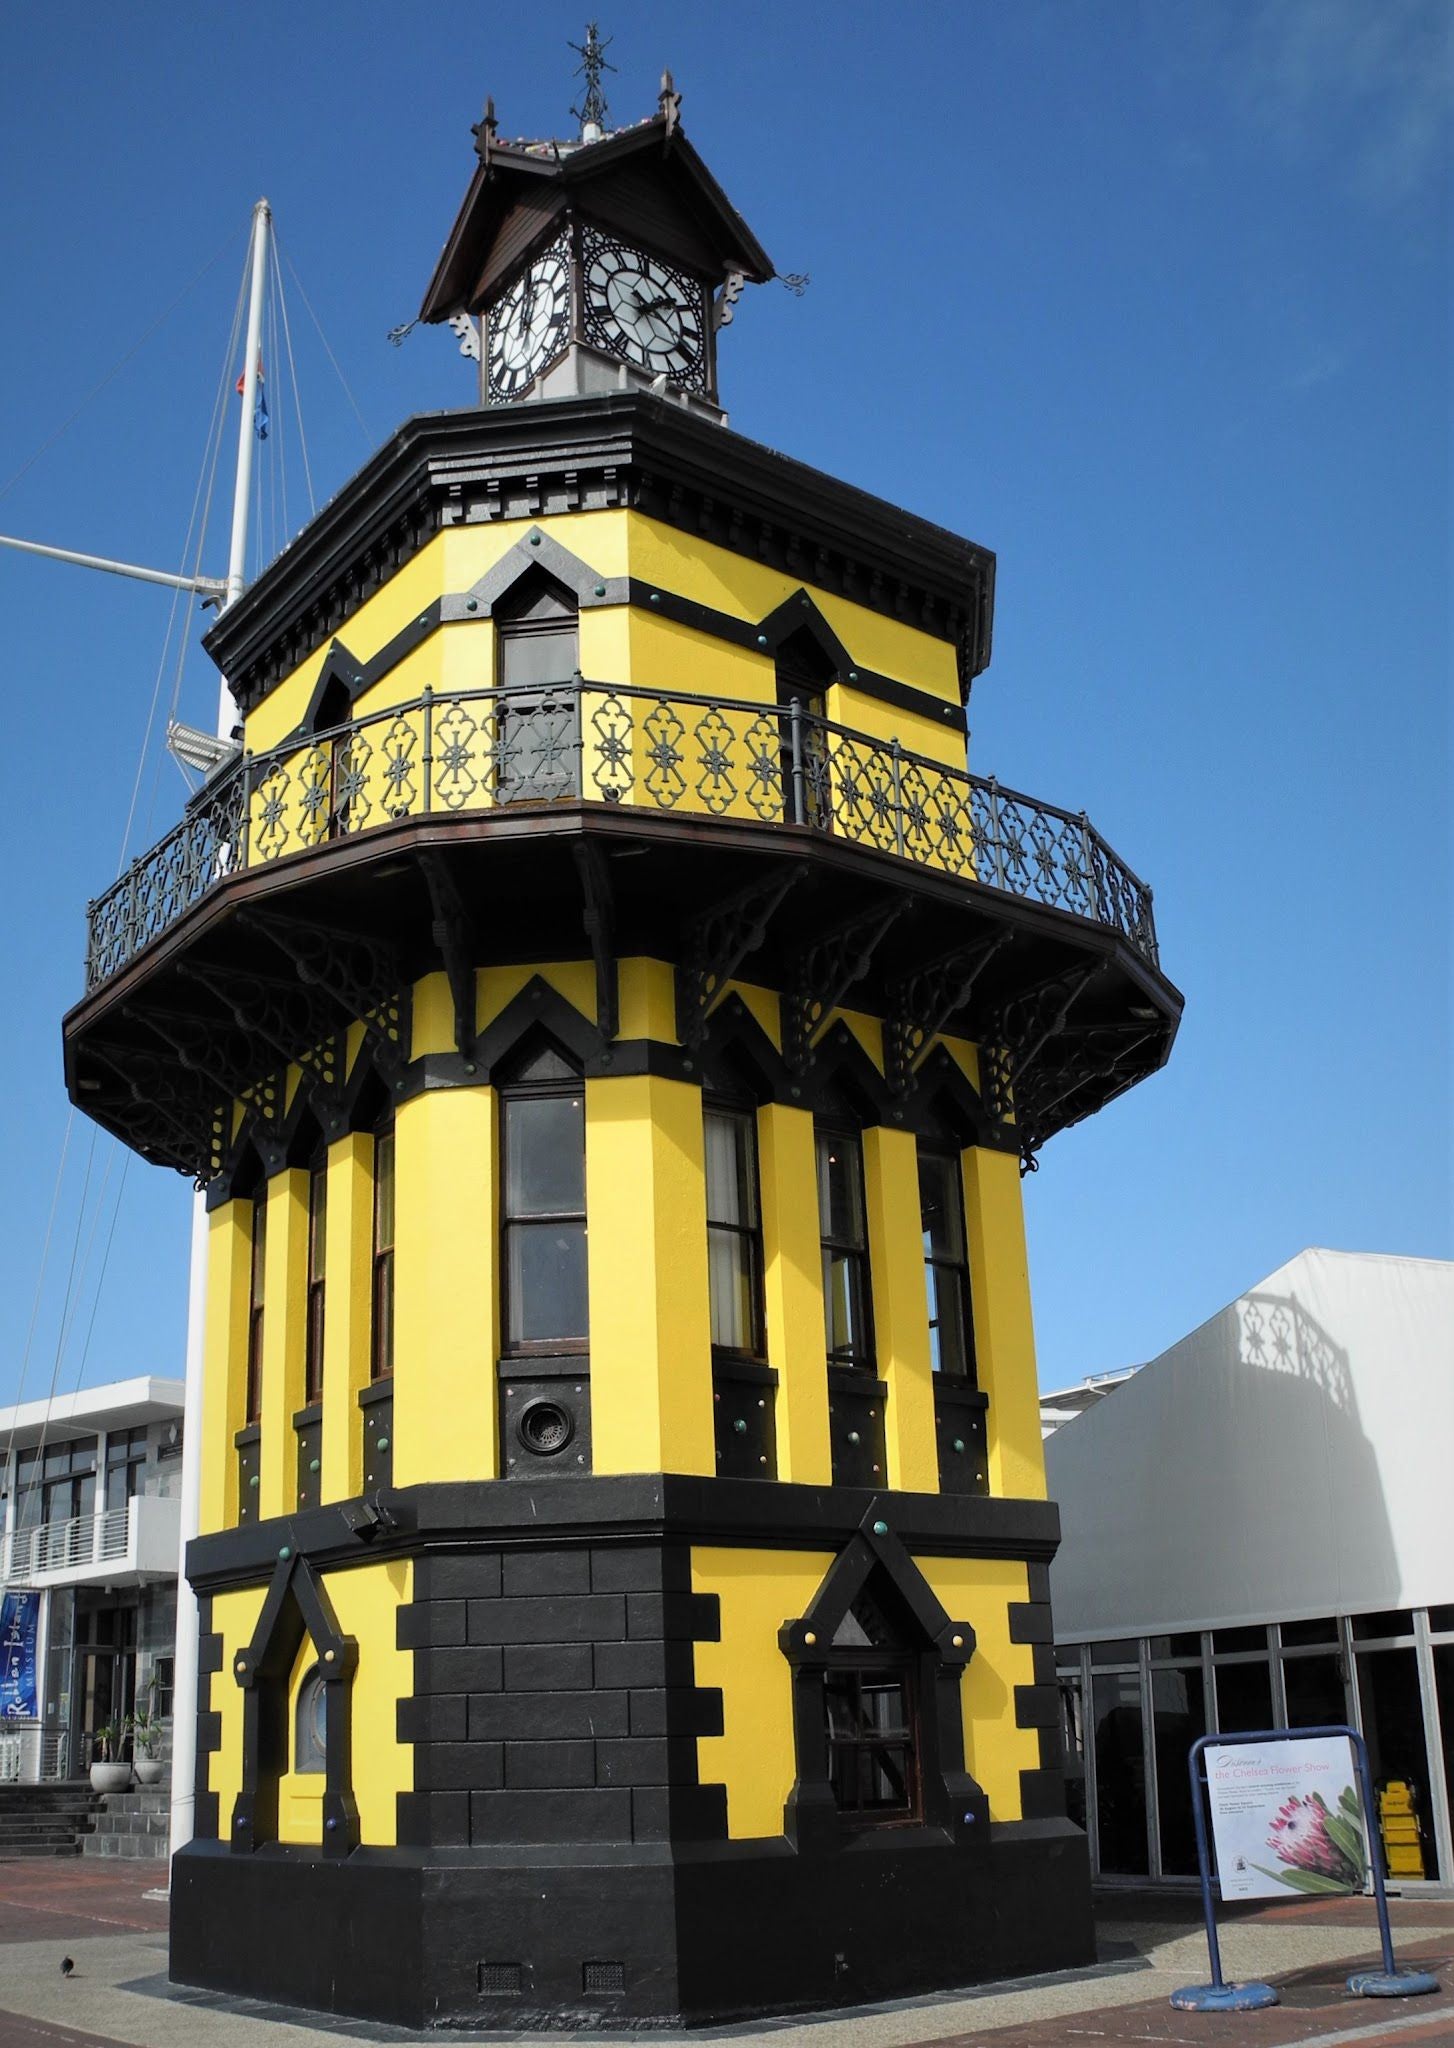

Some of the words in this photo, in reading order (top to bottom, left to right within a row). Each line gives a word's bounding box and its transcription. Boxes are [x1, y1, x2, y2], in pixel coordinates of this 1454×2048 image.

[4, 1594, 27, 1646] Island
[25, 1624, 35, 1687] MUSEUM
[1, 1656, 30, 1715] Robben
[1215, 1771, 1230, 1779] the
[1233, 1768, 1268, 1778] Chelsea
[1271, 1764, 1302, 1774] Flower
[1305, 1762, 1329, 1772] Show
